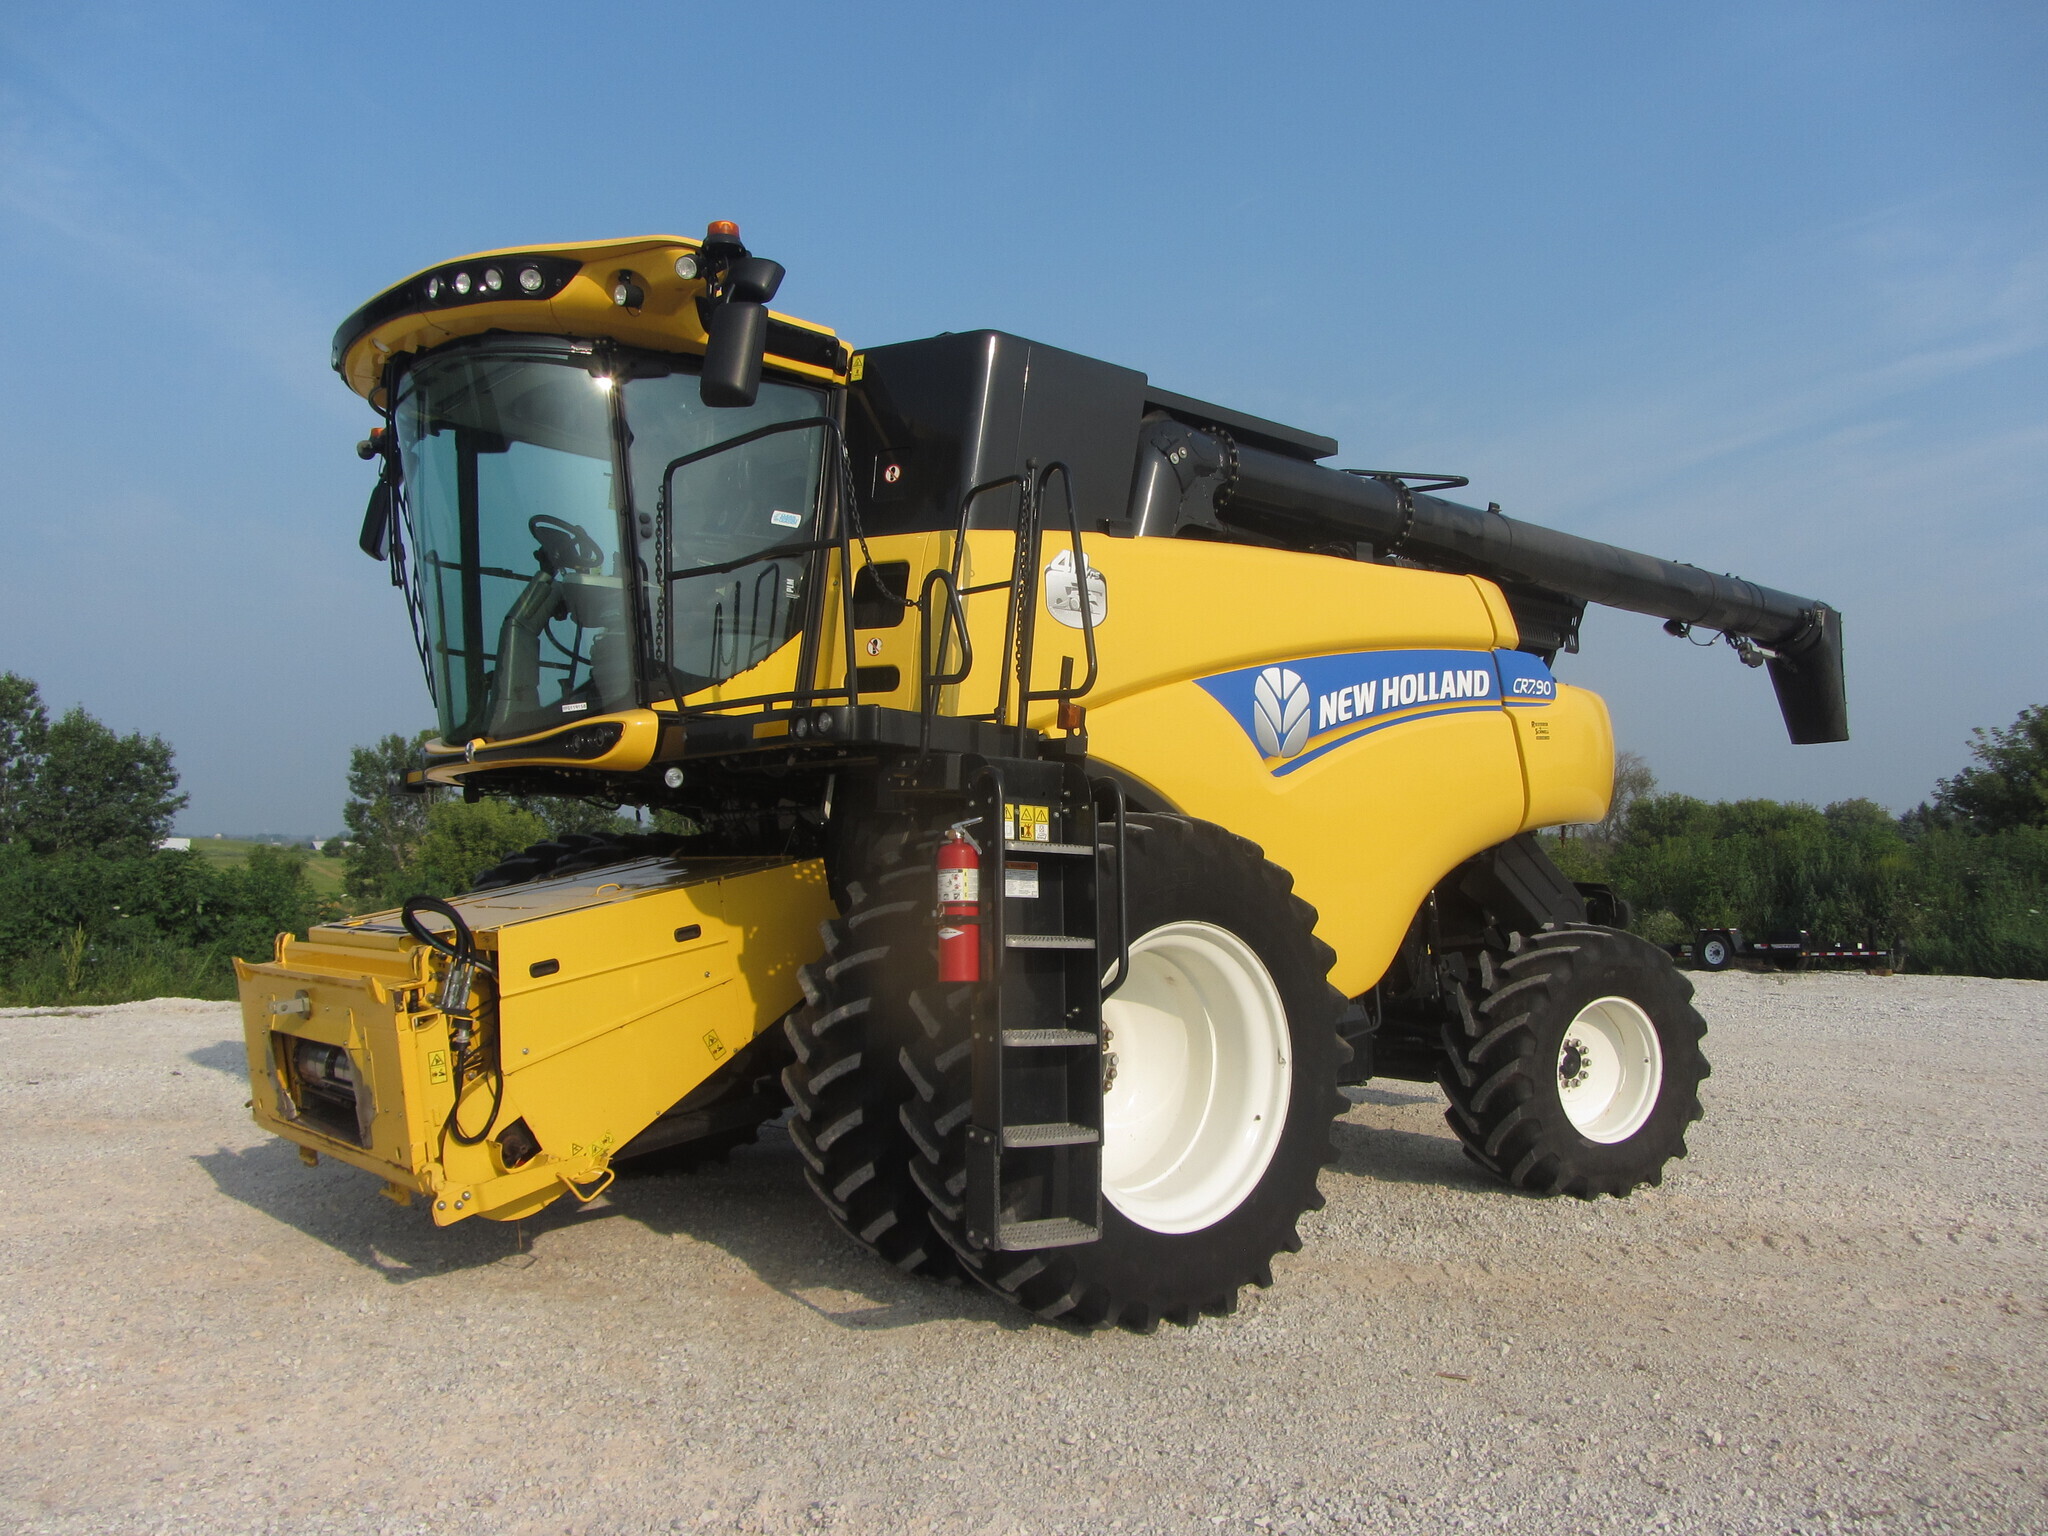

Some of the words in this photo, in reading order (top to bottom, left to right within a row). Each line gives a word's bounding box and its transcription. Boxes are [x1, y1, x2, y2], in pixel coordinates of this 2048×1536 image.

[786, 578, 795, 593] PLM
[1512, 677, 1552, 696] CR7.90
[1318, 679, 1377, 730] NEW
[1382, 669, 1490, 710] HOLLAND
